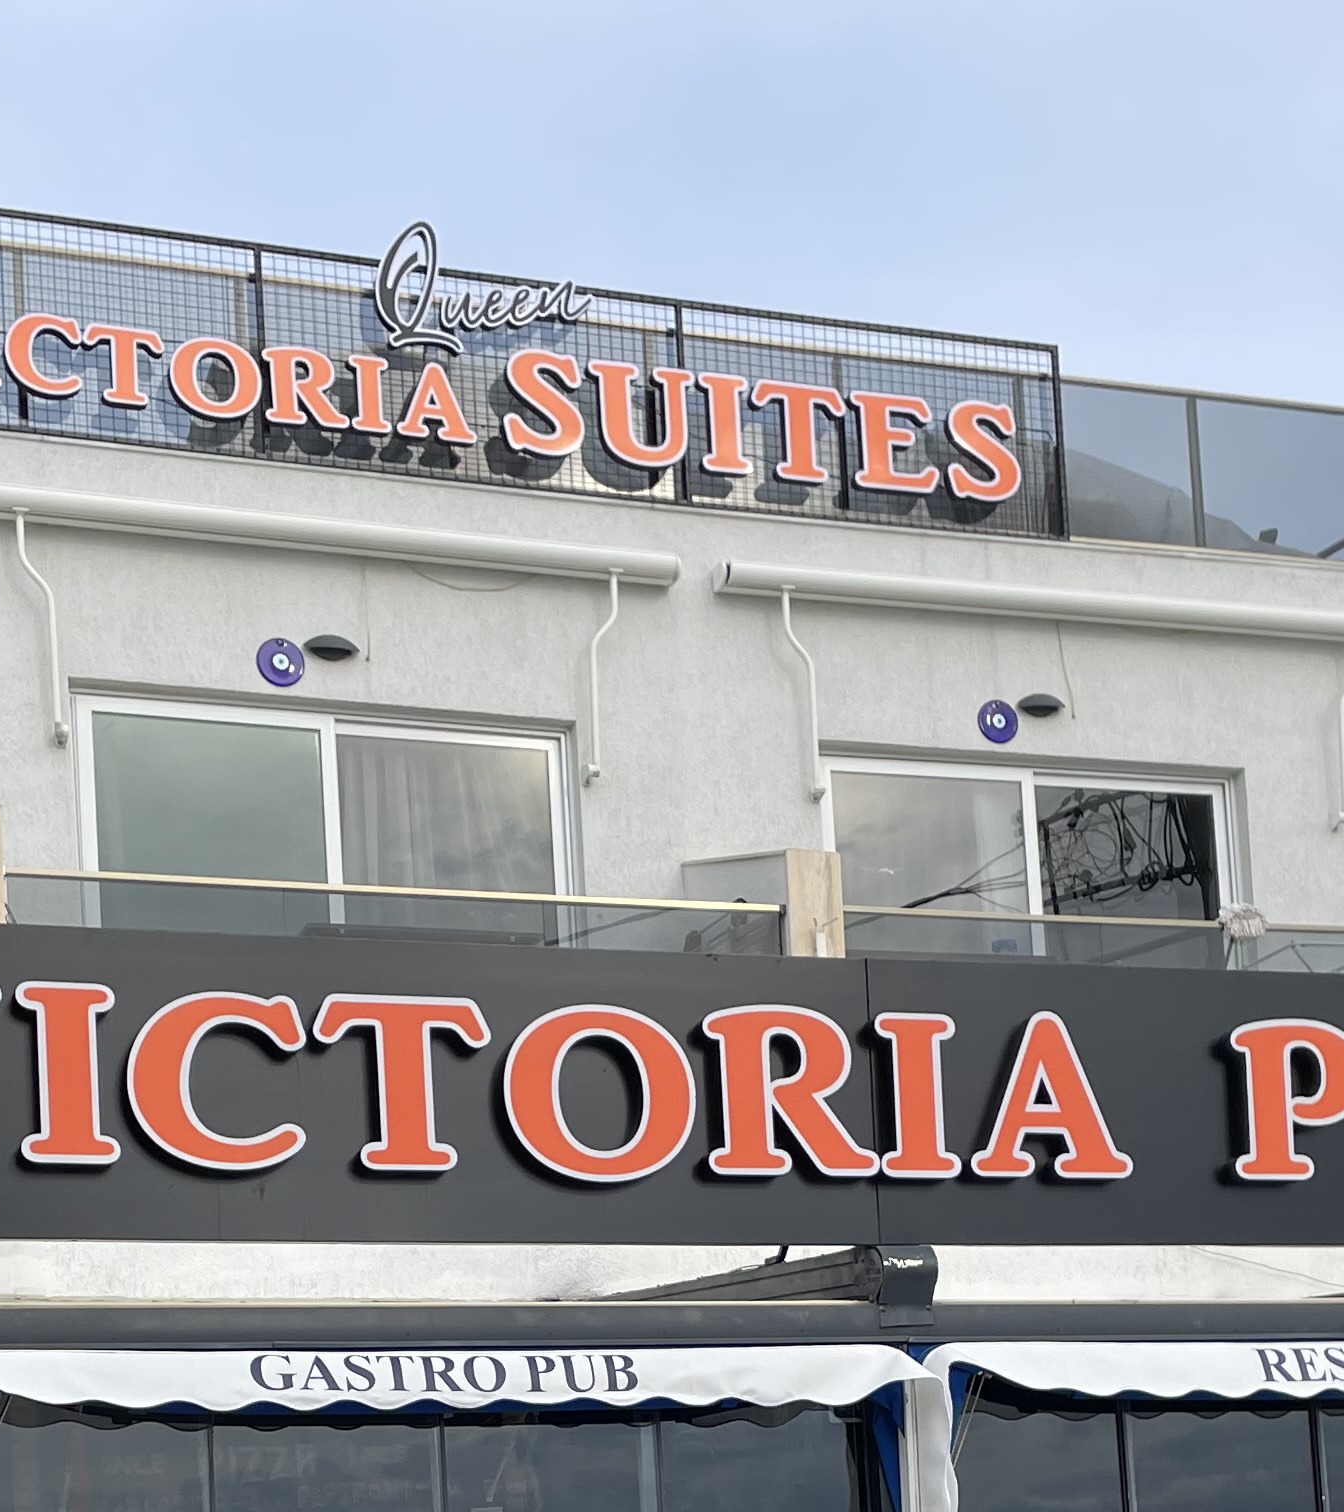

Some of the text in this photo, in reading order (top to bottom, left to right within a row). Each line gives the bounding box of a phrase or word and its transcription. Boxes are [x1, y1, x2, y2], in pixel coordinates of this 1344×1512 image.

[374, 220, 593, 354] Queen
[505, 348, 1023, 501] SUITES
[249, 1353, 640, 1393] GASTRO PUB
